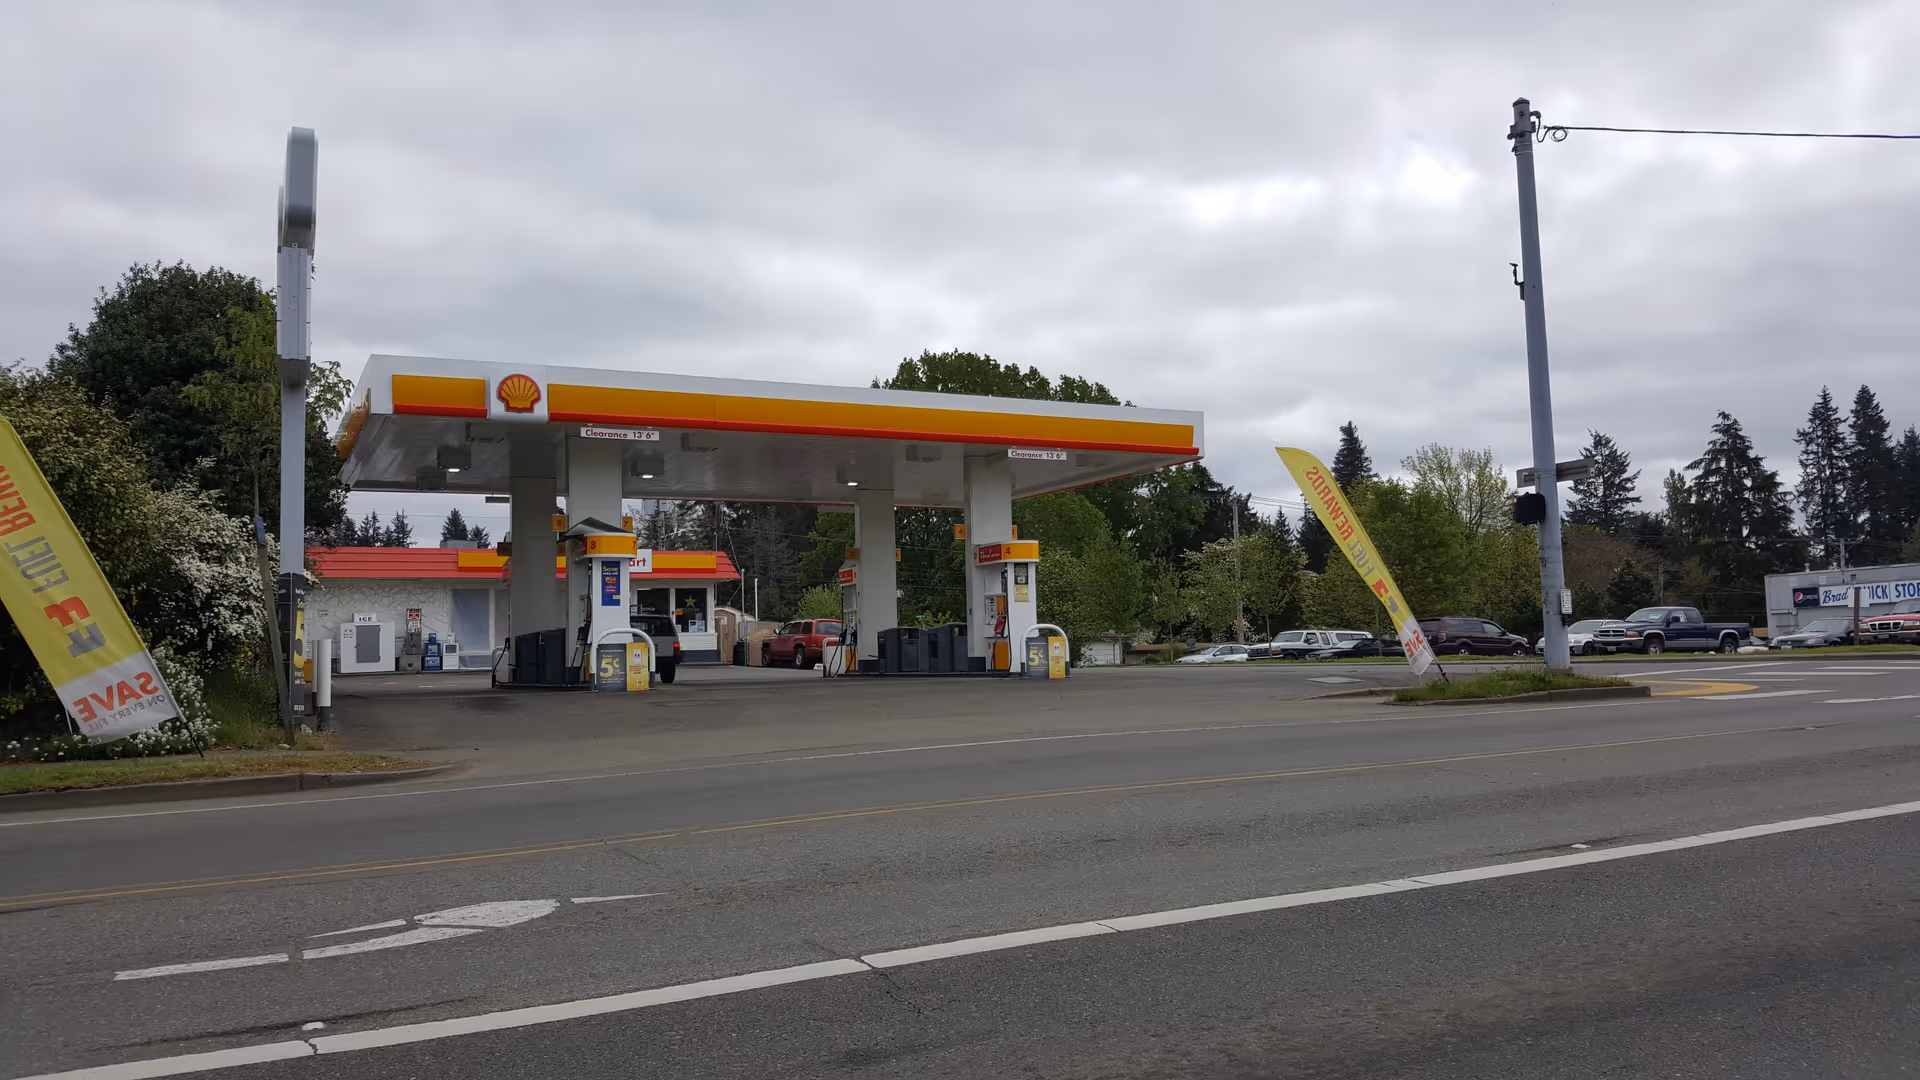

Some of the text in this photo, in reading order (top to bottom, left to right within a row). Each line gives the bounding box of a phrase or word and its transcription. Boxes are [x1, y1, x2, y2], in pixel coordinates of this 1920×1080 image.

[585, 429, 628, 439] Clearance
[1011, 450, 1042, 459] Clearance
[590, 540, 596, 550] 8
[1005, 546, 1011, 555] 4
[629, 557, 646, 567] art
